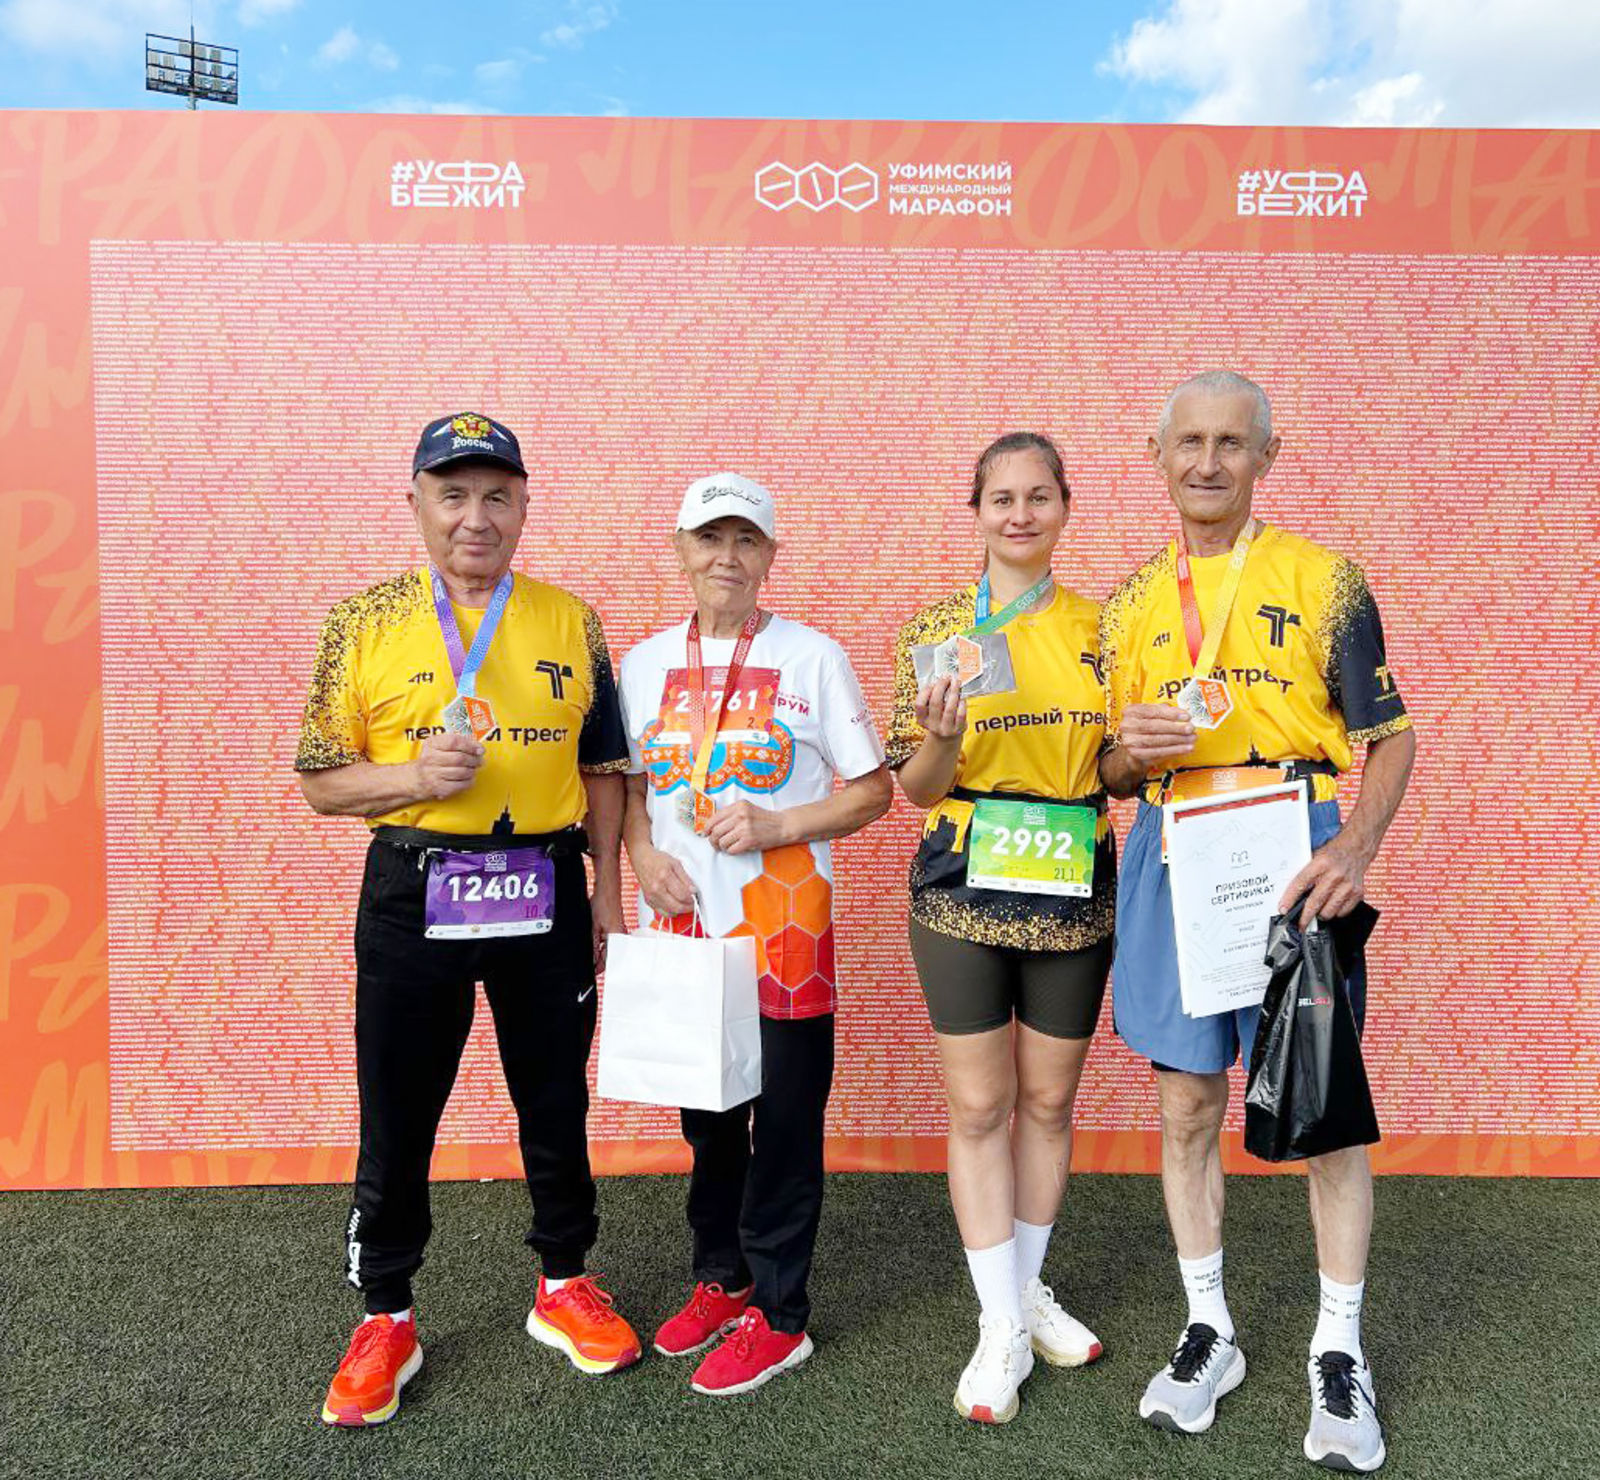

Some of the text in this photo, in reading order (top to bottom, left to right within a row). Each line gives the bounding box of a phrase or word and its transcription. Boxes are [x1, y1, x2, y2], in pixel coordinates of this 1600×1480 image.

[391, 160, 525, 184] #УФА
[888, 161, 1012, 180] УФИМСКИЙ
[889, 183, 1012, 195] МЕЖДУНАРОДНЫЙ
[1237, 170, 1367, 194] #УФА
[391, 184, 526, 207] БЕЖИТ
[1237, 193, 1368, 217] БЕЖИТ
[889, 198, 1012, 216] МАРАФОН
[974, 707, 1063, 733] первый
[507, 727, 568, 746] трест
[991, 826, 1073, 860] 2992
[1054, 867, 1075, 882] 21,1
[1215, 874, 1269, 893] ПРИЗОВОЙ
[448, 873, 539, 902] 12406
[1211, 884, 1276, 906] СЕРТИФИКАТ
[525, 904, 539, 919] 10
